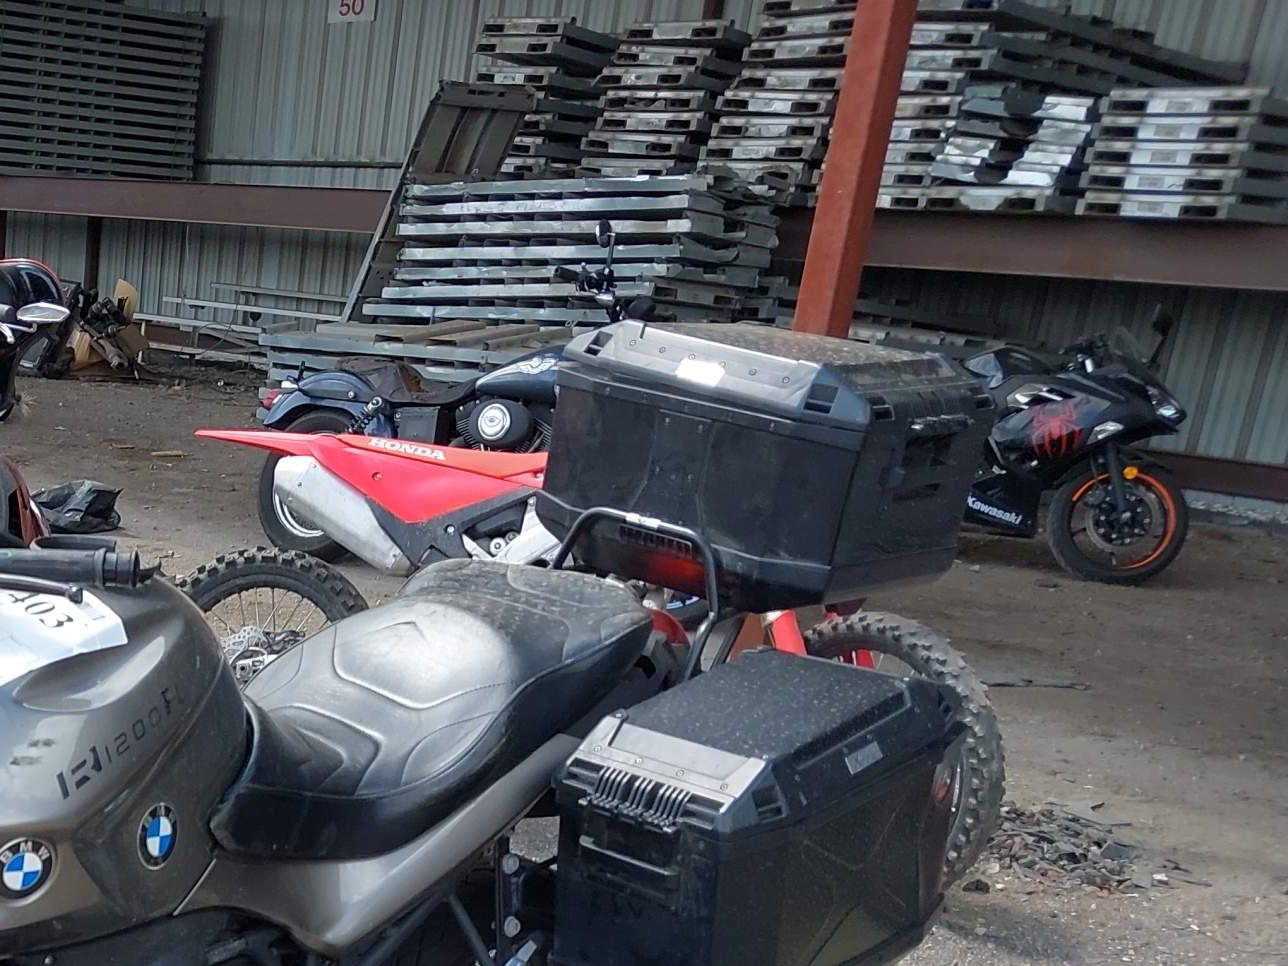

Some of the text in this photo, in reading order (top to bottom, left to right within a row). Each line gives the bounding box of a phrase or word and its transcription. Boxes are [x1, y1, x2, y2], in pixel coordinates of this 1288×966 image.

[339, 0, 365, 16] 50
[368, 437, 447, 461] HONDA
[967, 495, 1023, 525] Kawasaki
[0, 840, 51, 864] BMW
